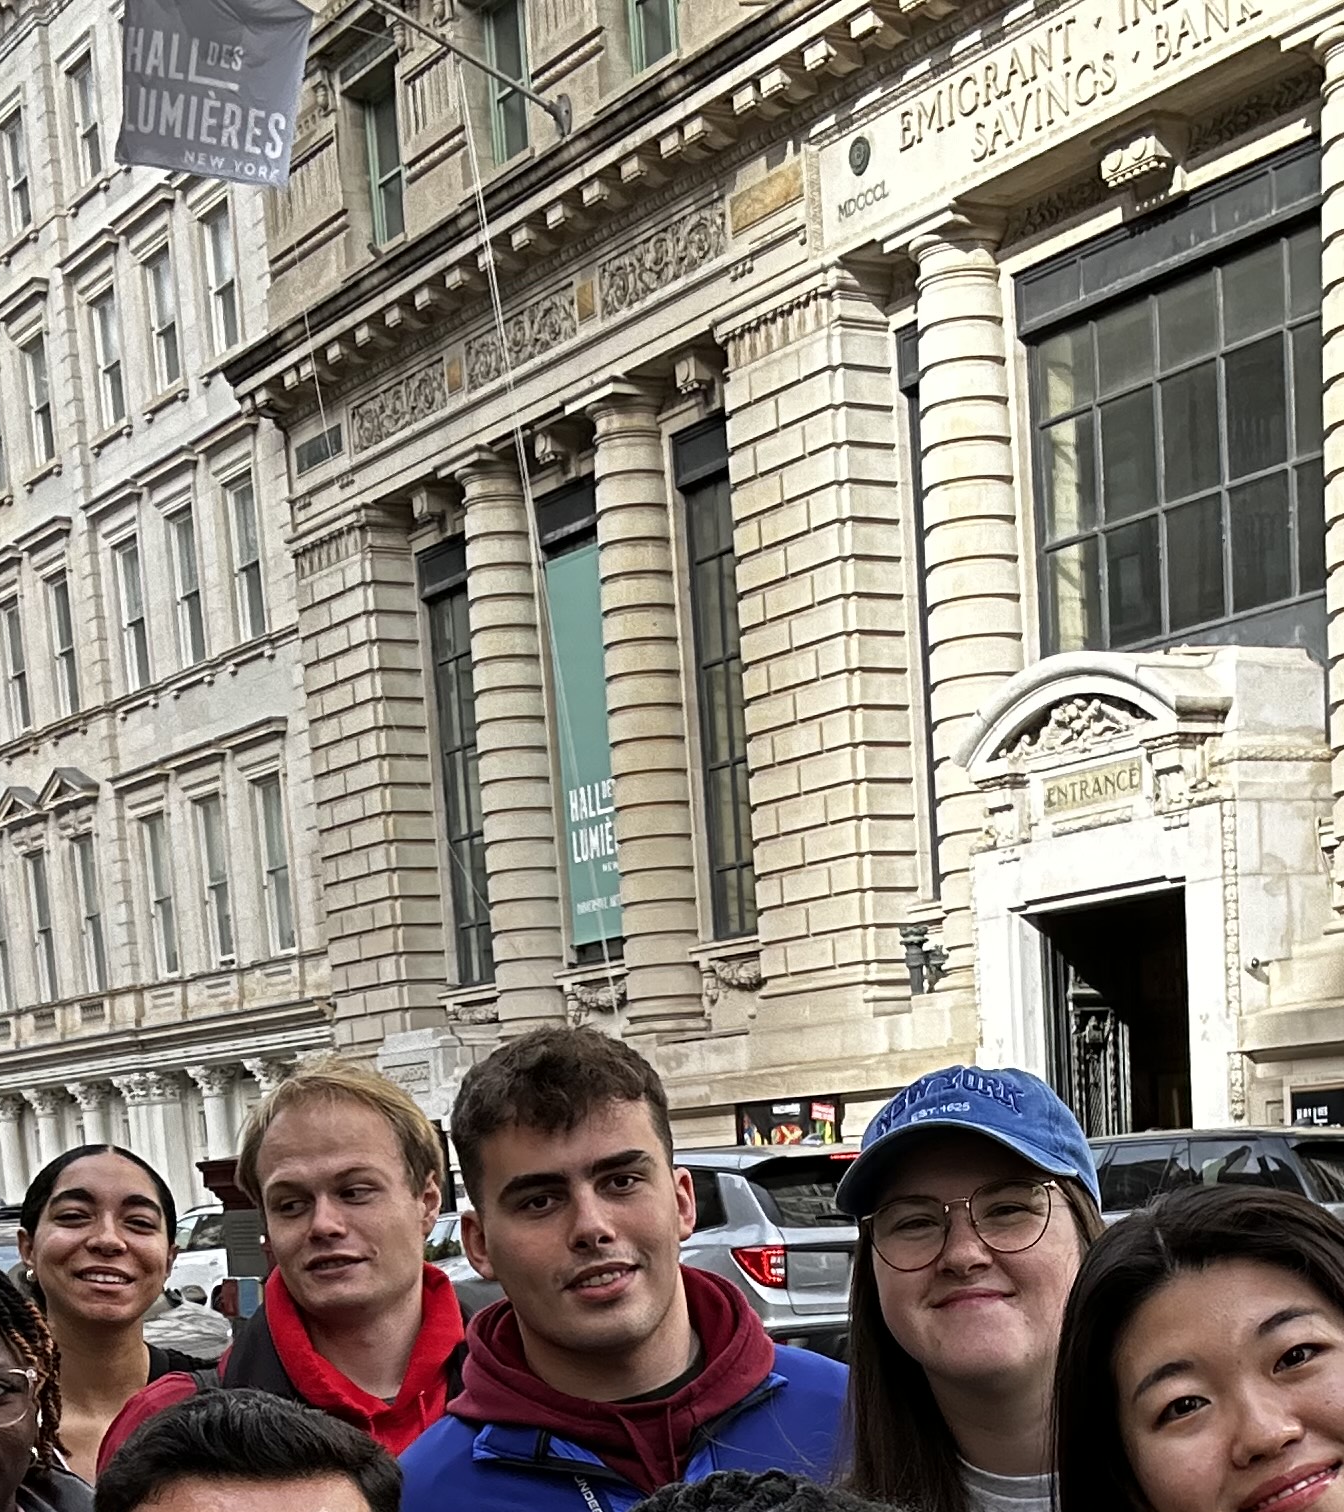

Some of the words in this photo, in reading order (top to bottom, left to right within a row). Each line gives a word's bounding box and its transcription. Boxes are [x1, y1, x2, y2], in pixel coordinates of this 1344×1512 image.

[126, 27, 240, 93] HALL
[207, 41, 244, 72] DES
[899, 15, 1077, 154] EMIGRANT
[125, 85, 286, 159] LUMIÈRES
[971, 51, 1117, 163] SAVINGS
[184, 150, 225, 169] NEW
[233, 159, 279, 179] YORK
[569, 782, 615, 822] HALL
[1046, 766, 1141, 808] ENTRANCE
[572, 815, 618, 864] LUMIÈ
